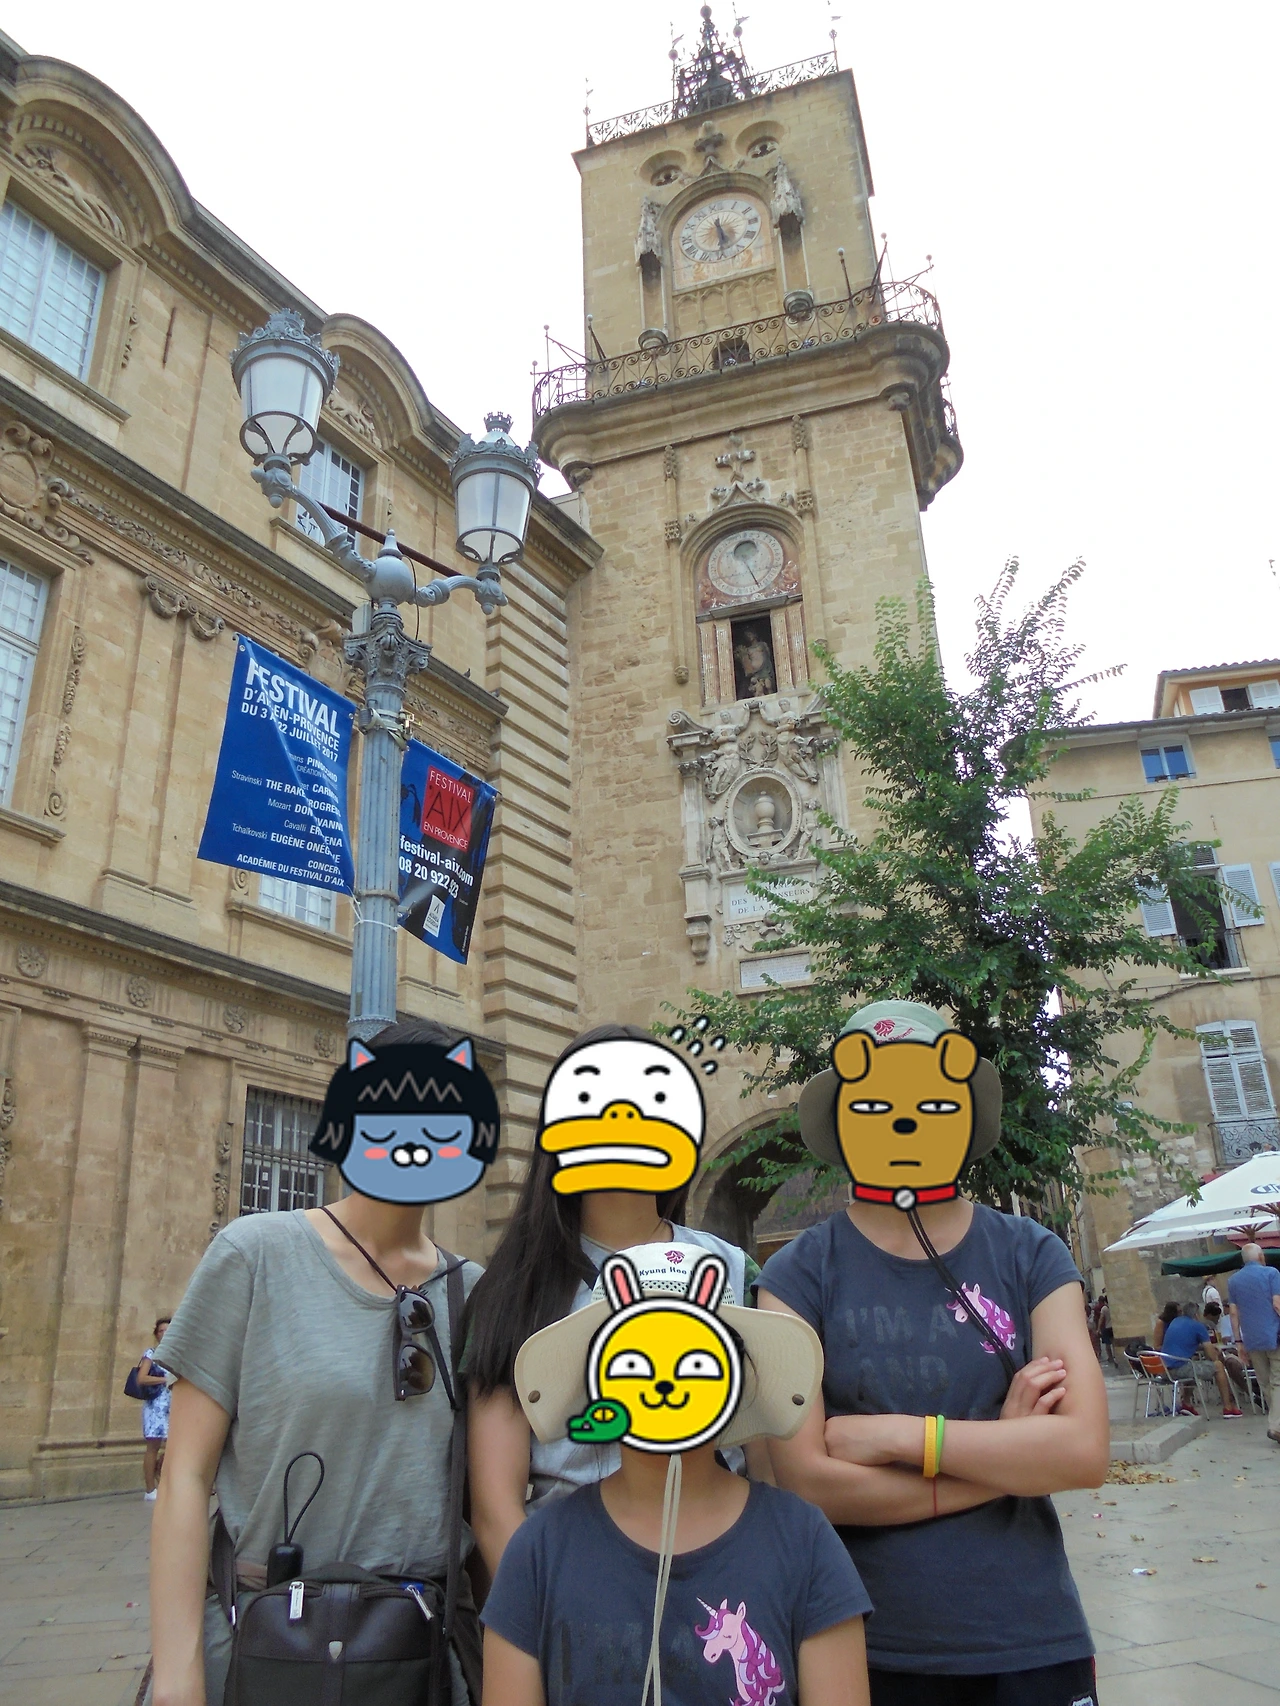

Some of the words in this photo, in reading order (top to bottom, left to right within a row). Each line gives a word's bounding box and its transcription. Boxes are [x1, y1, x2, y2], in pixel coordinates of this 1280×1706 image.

[246, 657, 340, 739] FESTIVAL
[241, 702, 258, 716] DU
[260, 708, 268, 719] 3
[278, 721, 288, 734] 22
[290, 728, 321, 750] JUILLET
[322, 746, 338, 762] 2017
[231, 770, 262, 786] Stravinski
[266, 778, 282, 792] THE
[429, 770, 471, 804] FESTIVAL
[268, 798, 292, 811] Mozart
[294, 804, 313, 816] DON
[284, 820, 306, 832] Cavalli
[424, 822, 434, 833] EN
[434, 827, 468, 849] PROVENCE
[270, 832, 306, 849] EUGÈNE
[236, 854, 276, 870] ACADÉMIE
[278, 864, 290, 873] DU
[290, 866, 323, 882] FESTIVAL
[324, 874, 344, 886] D'AIX
[398, 856, 412, 874] 08
[414, 864, 428, 880] 20
[430, 870, 450, 890] 922
[731, 898, 748, 906] DES
[640, 1268, 666, 1276] Kyung
[846, 1305, 913, 1344] I'M
[928, 1304, 959, 1343] A
